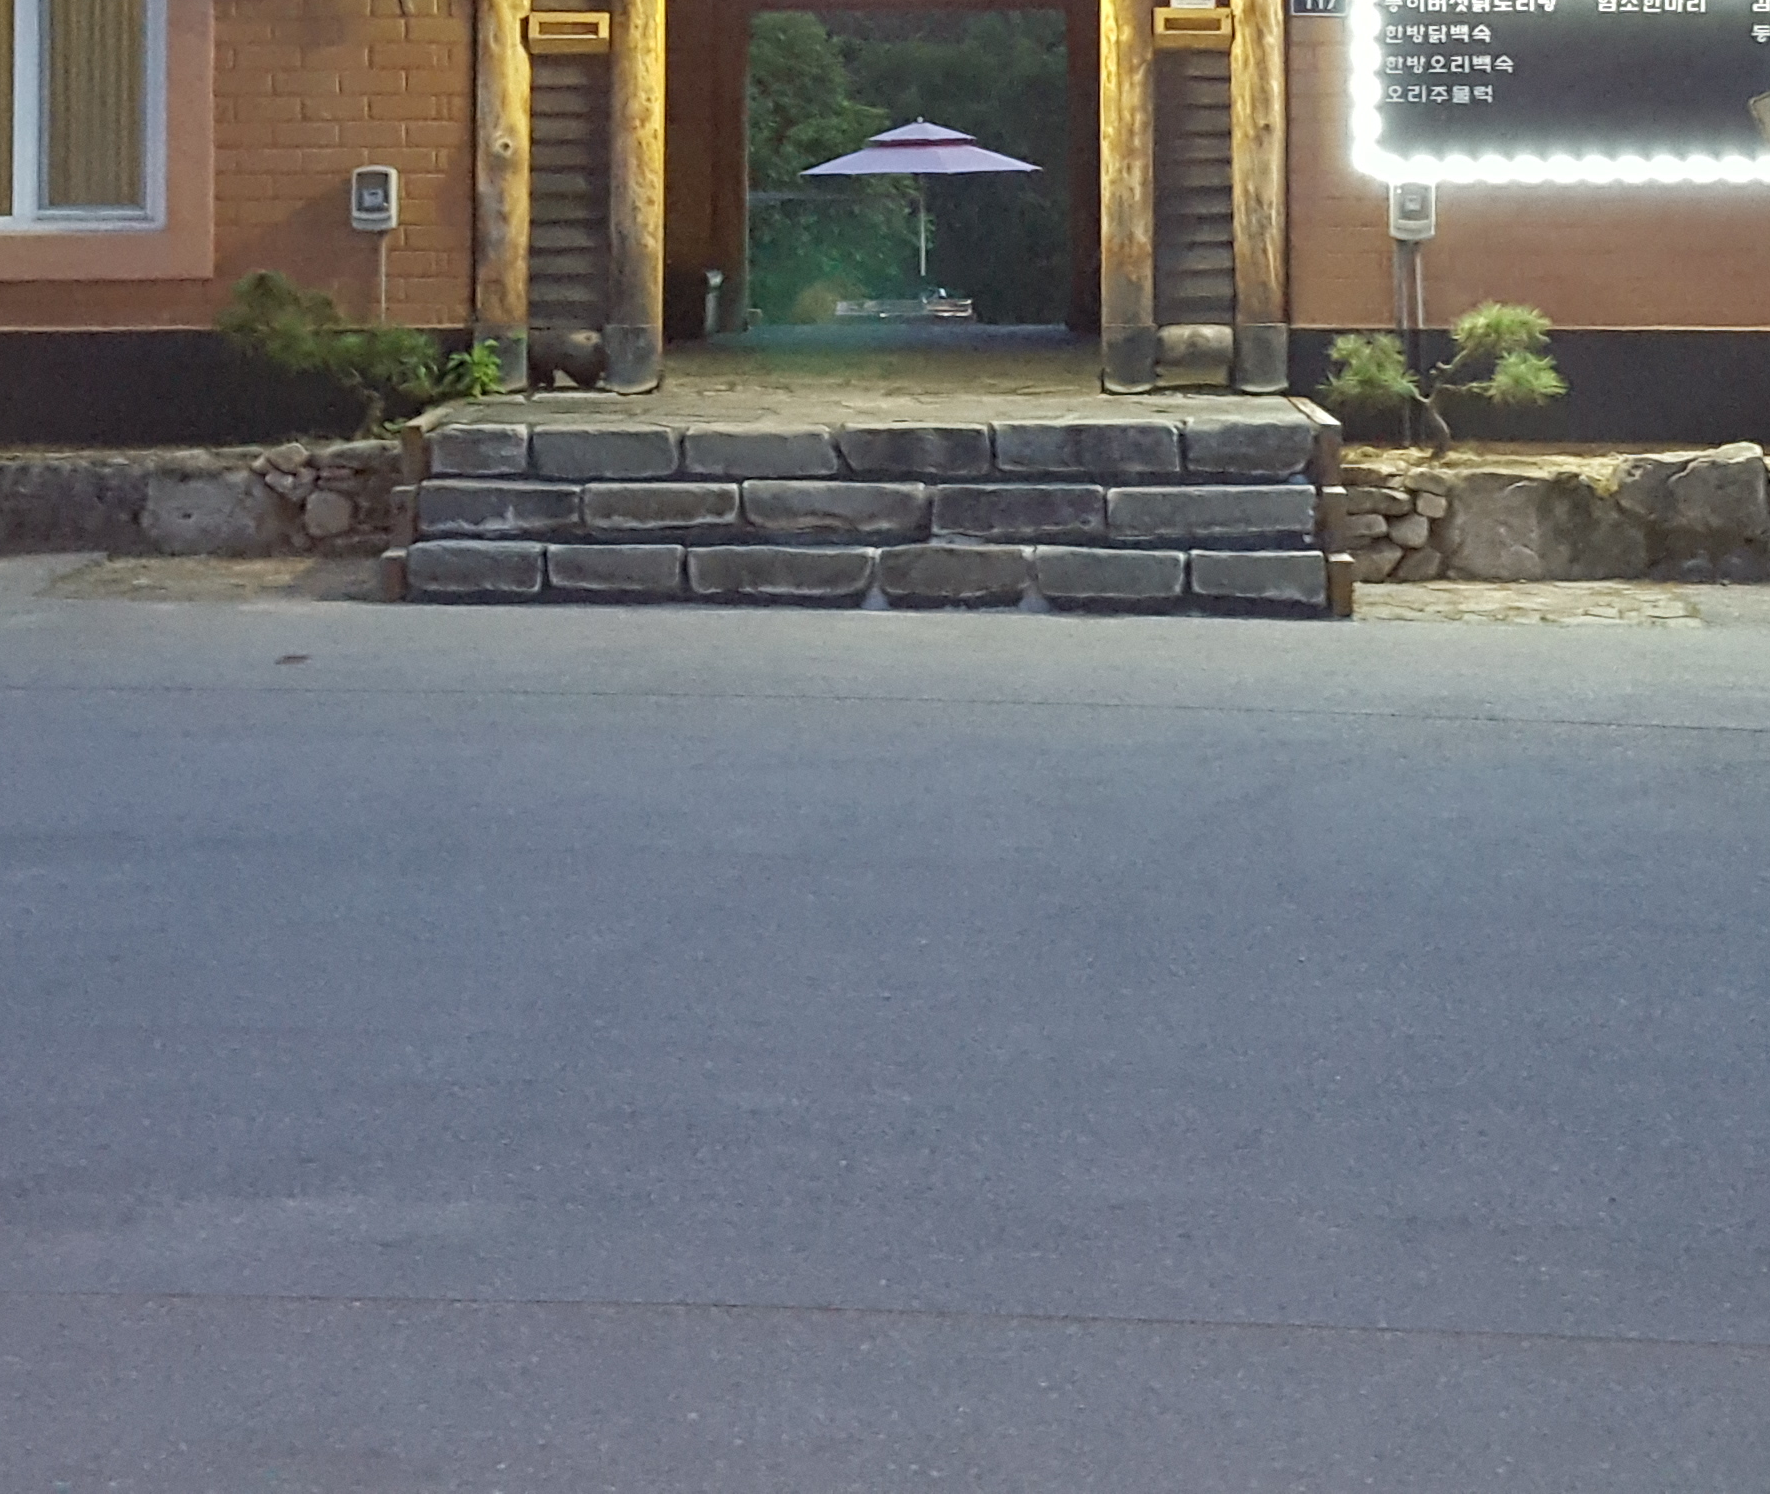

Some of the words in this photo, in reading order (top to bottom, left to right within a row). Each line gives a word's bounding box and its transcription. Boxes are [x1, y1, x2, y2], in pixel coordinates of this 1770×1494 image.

[1385, 24, 1492, 44] 한방닭백숙
[1385, 55, 1515, 74] 한방오리백숙
[1385, 85, 1494, 104] 오리주물럭
